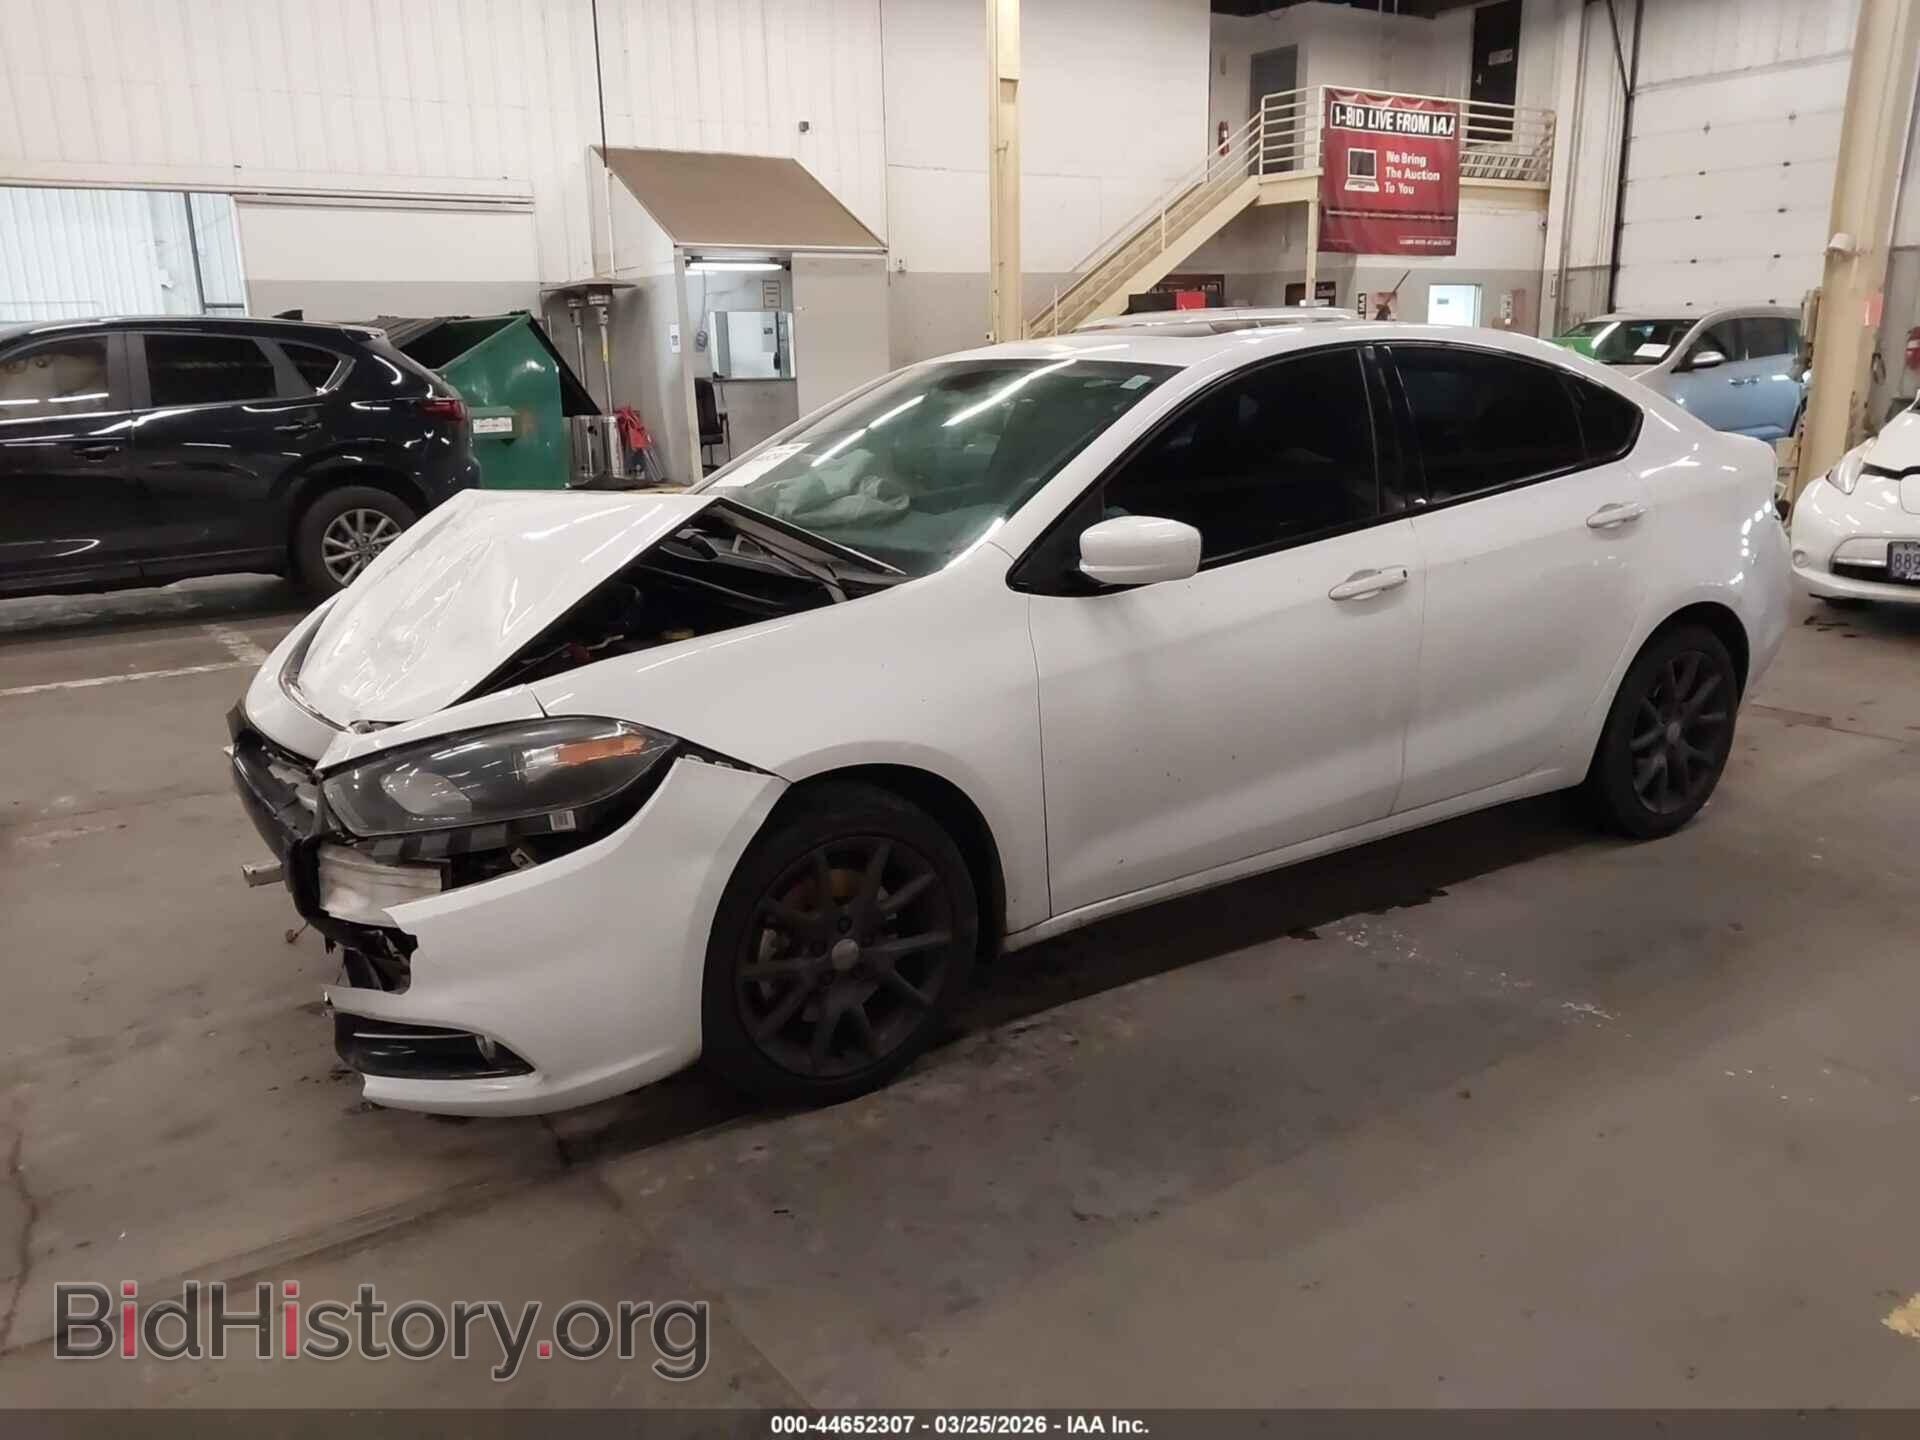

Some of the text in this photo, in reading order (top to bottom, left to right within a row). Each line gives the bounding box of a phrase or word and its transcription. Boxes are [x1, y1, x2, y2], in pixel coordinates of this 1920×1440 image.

[1335, 105, 1365, 127] I-BID
[1368, 109, 1394, 131] LIVE
[1396, 112, 1430, 134] FROM
[1386, 150, 1427, 168] We Bring
[1385, 166, 1440, 181] The Auction
[1384, 181, 1415, 194] To You
